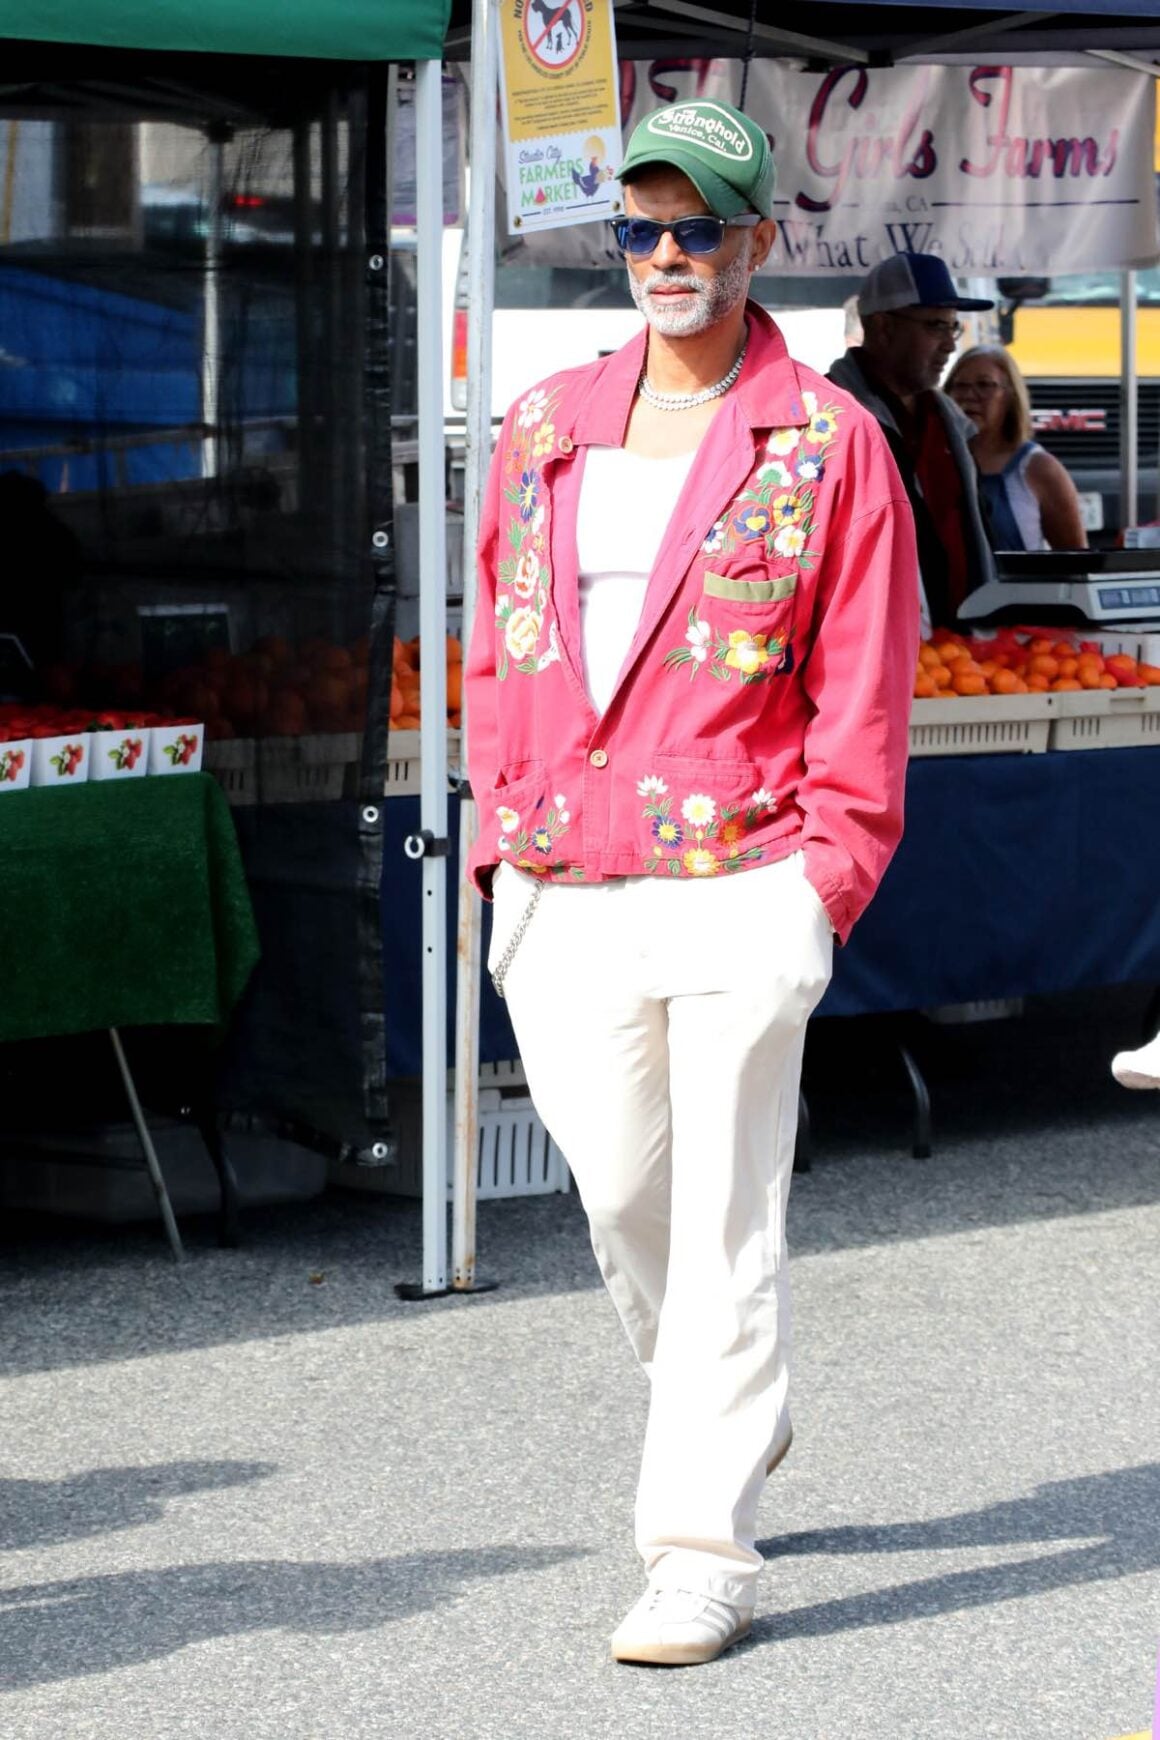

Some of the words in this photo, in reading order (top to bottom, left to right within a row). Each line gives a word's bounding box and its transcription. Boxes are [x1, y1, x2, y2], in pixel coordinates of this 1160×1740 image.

[658, 109, 746, 154] Stronghold
[668, 123, 706, 140] Venice,
[707, 134, 728, 153] Cal.
[795, 64, 937, 213] Girls
[959, 65, 1120, 178] Farms
[546, 144, 562, 166] City
[519, 158, 584, 185] FARMERS
[776, 219, 870, 268] What
[1029, 409, 1106, 431] GMC
